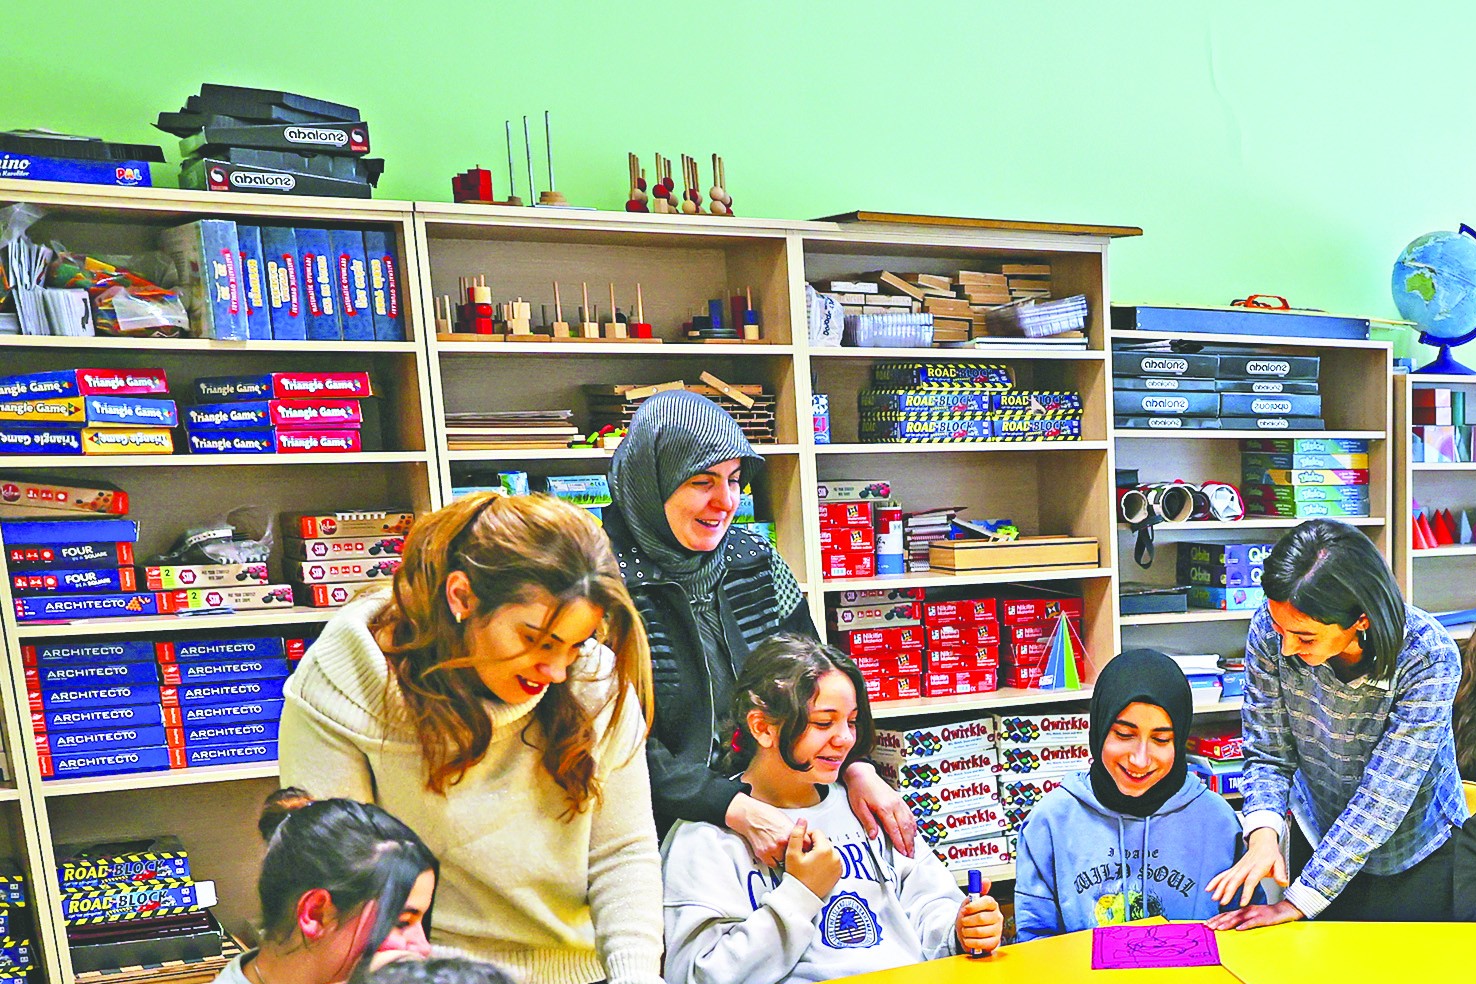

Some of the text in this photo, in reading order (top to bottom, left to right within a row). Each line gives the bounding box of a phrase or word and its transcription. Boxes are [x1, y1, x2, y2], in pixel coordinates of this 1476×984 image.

[116, 167, 142, 181] PAL
[927, 367, 957, 378] ROAD
[29, 382, 63, 394] Game
[84, 374, 156, 390] Triangle Game
[200, 382, 262, 396] Triangle Game
[281, 377, 356, 393] Triangle Game
[905, 395, 974, 406] ROAD BLOCK
[1001, 395, 1030, 406] ROAD
[36, 402, 69, 416] Game
[92, 400, 164, 421] Triangle Game
[277, 405, 348, 420] Triangle Game
[190, 410, 258, 424] Triangle Game
[906, 420, 974, 433] ROAD BLOCK
[1001, 420, 1066, 432] ROAD BLOCK
[33, 434, 79, 449] Triangle
[99, 431, 170, 447] Triangle Game
[191, 436, 262, 451] Triangle Game
[279, 434, 348, 449] Triangle Game
[61, 545, 94, 558] FOUR
[64, 571, 97, 585] FOUR
[165, 569, 170, 577] 2
[191, 592, 198, 600] 2
[45, 599, 126, 610] ARCHITECTO
[42, 646, 124, 659] ARCHITECTO
[180, 643, 256, 656] ARCHITECTO
[47, 666, 128, 678] ARCHITECTO
[187, 662, 263, 675] ARCHITECTO
[50, 688, 131, 701] ARCHITECTO
[185, 684, 260, 697] ARCHITECTO
[53, 709, 134, 722] ARCHITECTO
[187, 704, 262, 718] ARCHITECTO
[189, 724, 265, 738] ARCHITECTO
[1040, 716, 1089, 732] Qwirkle
[56, 730, 137, 744] ARCHITECTO
[940, 722, 988, 742] Qwirkle
[191, 745, 267, 760] ARCHITECTO
[1040, 744, 1089, 761] Qwirkle
[58, 753, 139, 768] ARCHITECTO
[939, 754, 991, 774] Qwirkle
[940, 782, 991, 802] Qwirkle
[946, 809, 997, 829] Qwirkle
[948, 841, 999, 860] Qwirkle
[63, 859, 166, 881] ROAD BLOCK
[1073, 862, 1196, 898] WILD SOUL
[68, 889, 169, 914] ROAD BLOCK
